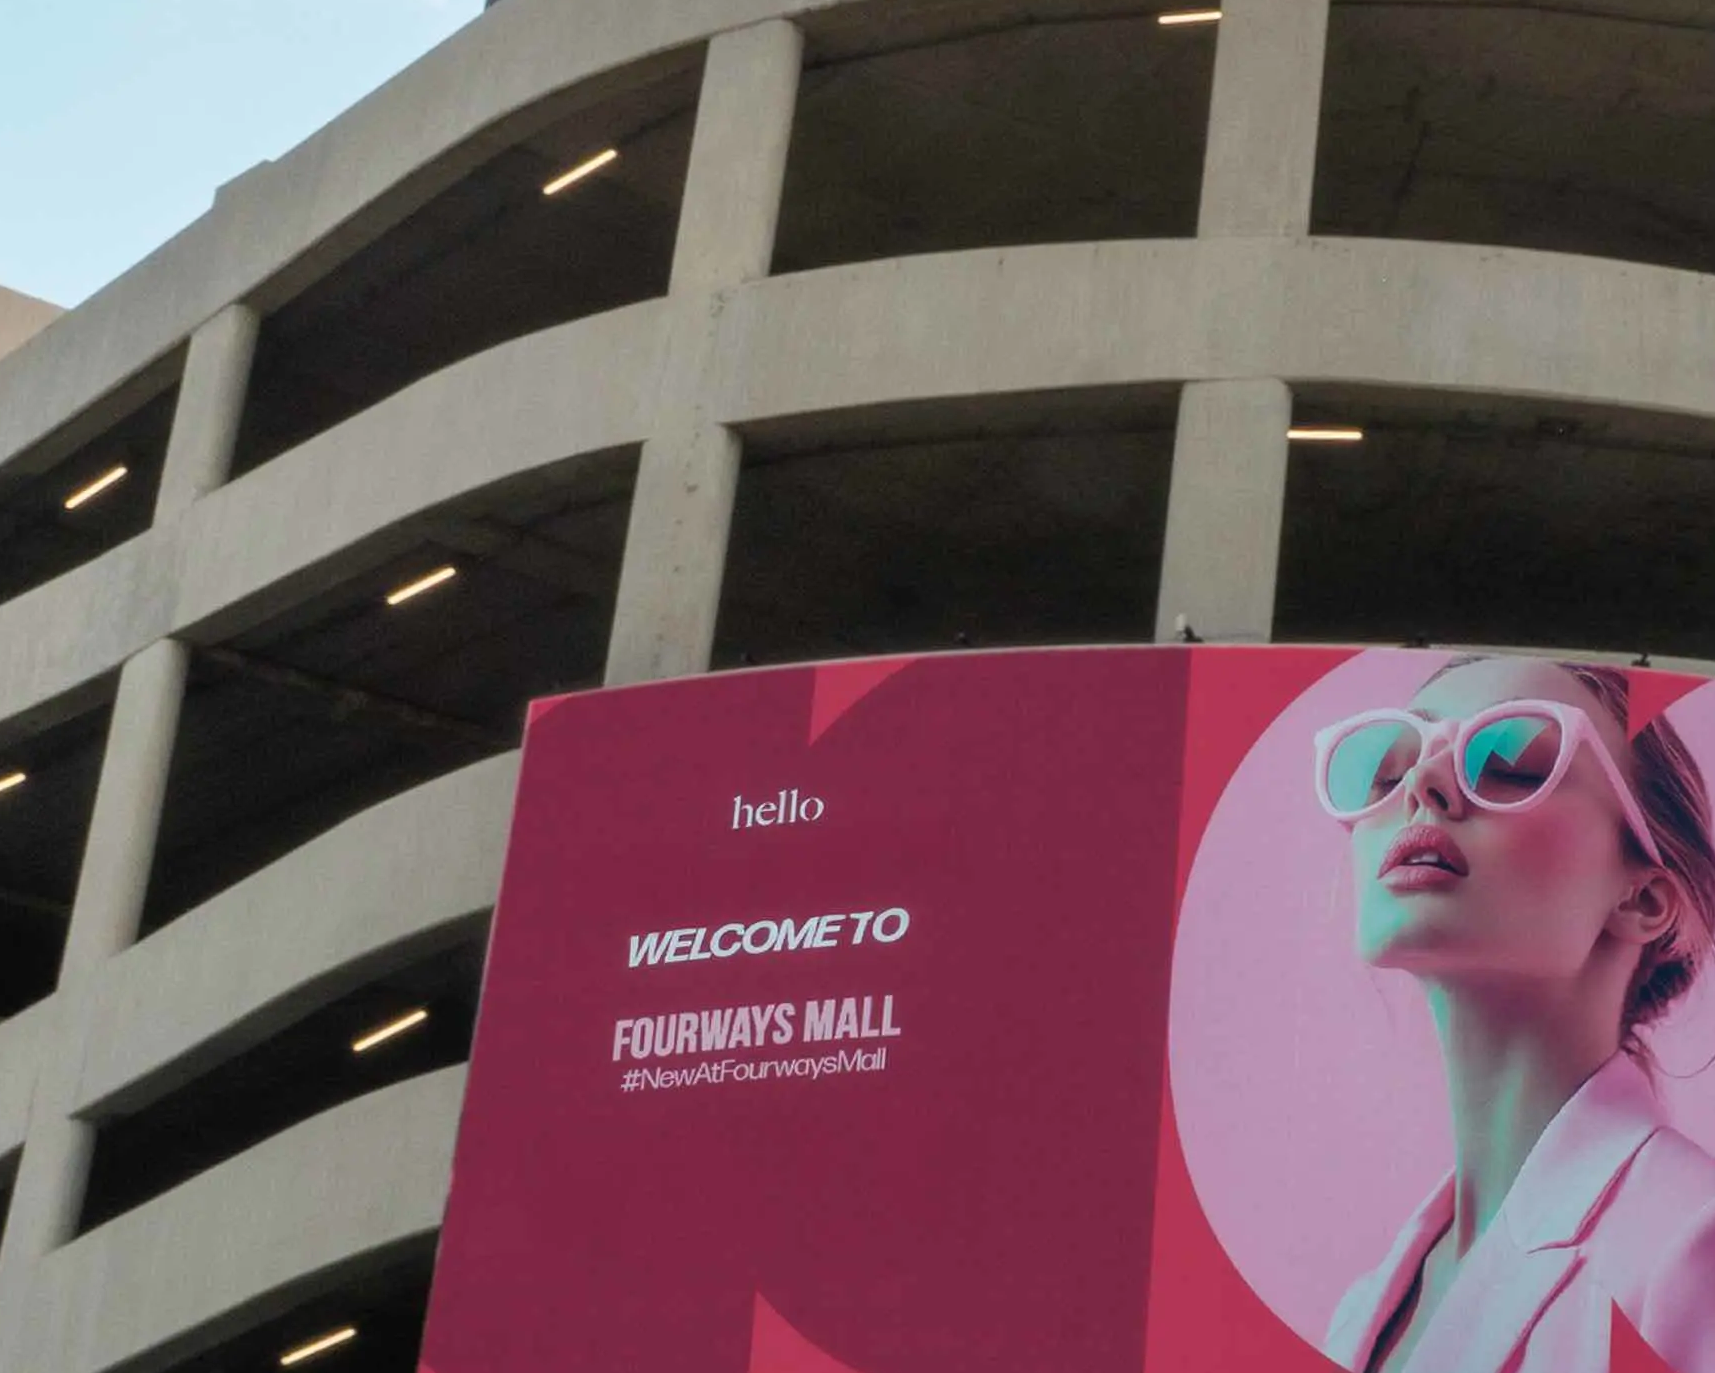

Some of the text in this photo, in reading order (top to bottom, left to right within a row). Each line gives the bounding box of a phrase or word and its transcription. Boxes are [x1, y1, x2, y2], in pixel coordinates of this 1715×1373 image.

[732, 788, 825, 830] hello
[628, 907, 910, 968] WELCOME TO
[612, 994, 902, 1062] FOURWAYS MALL
[620, 1046, 887, 1093] #NewAtFourwaysMall
